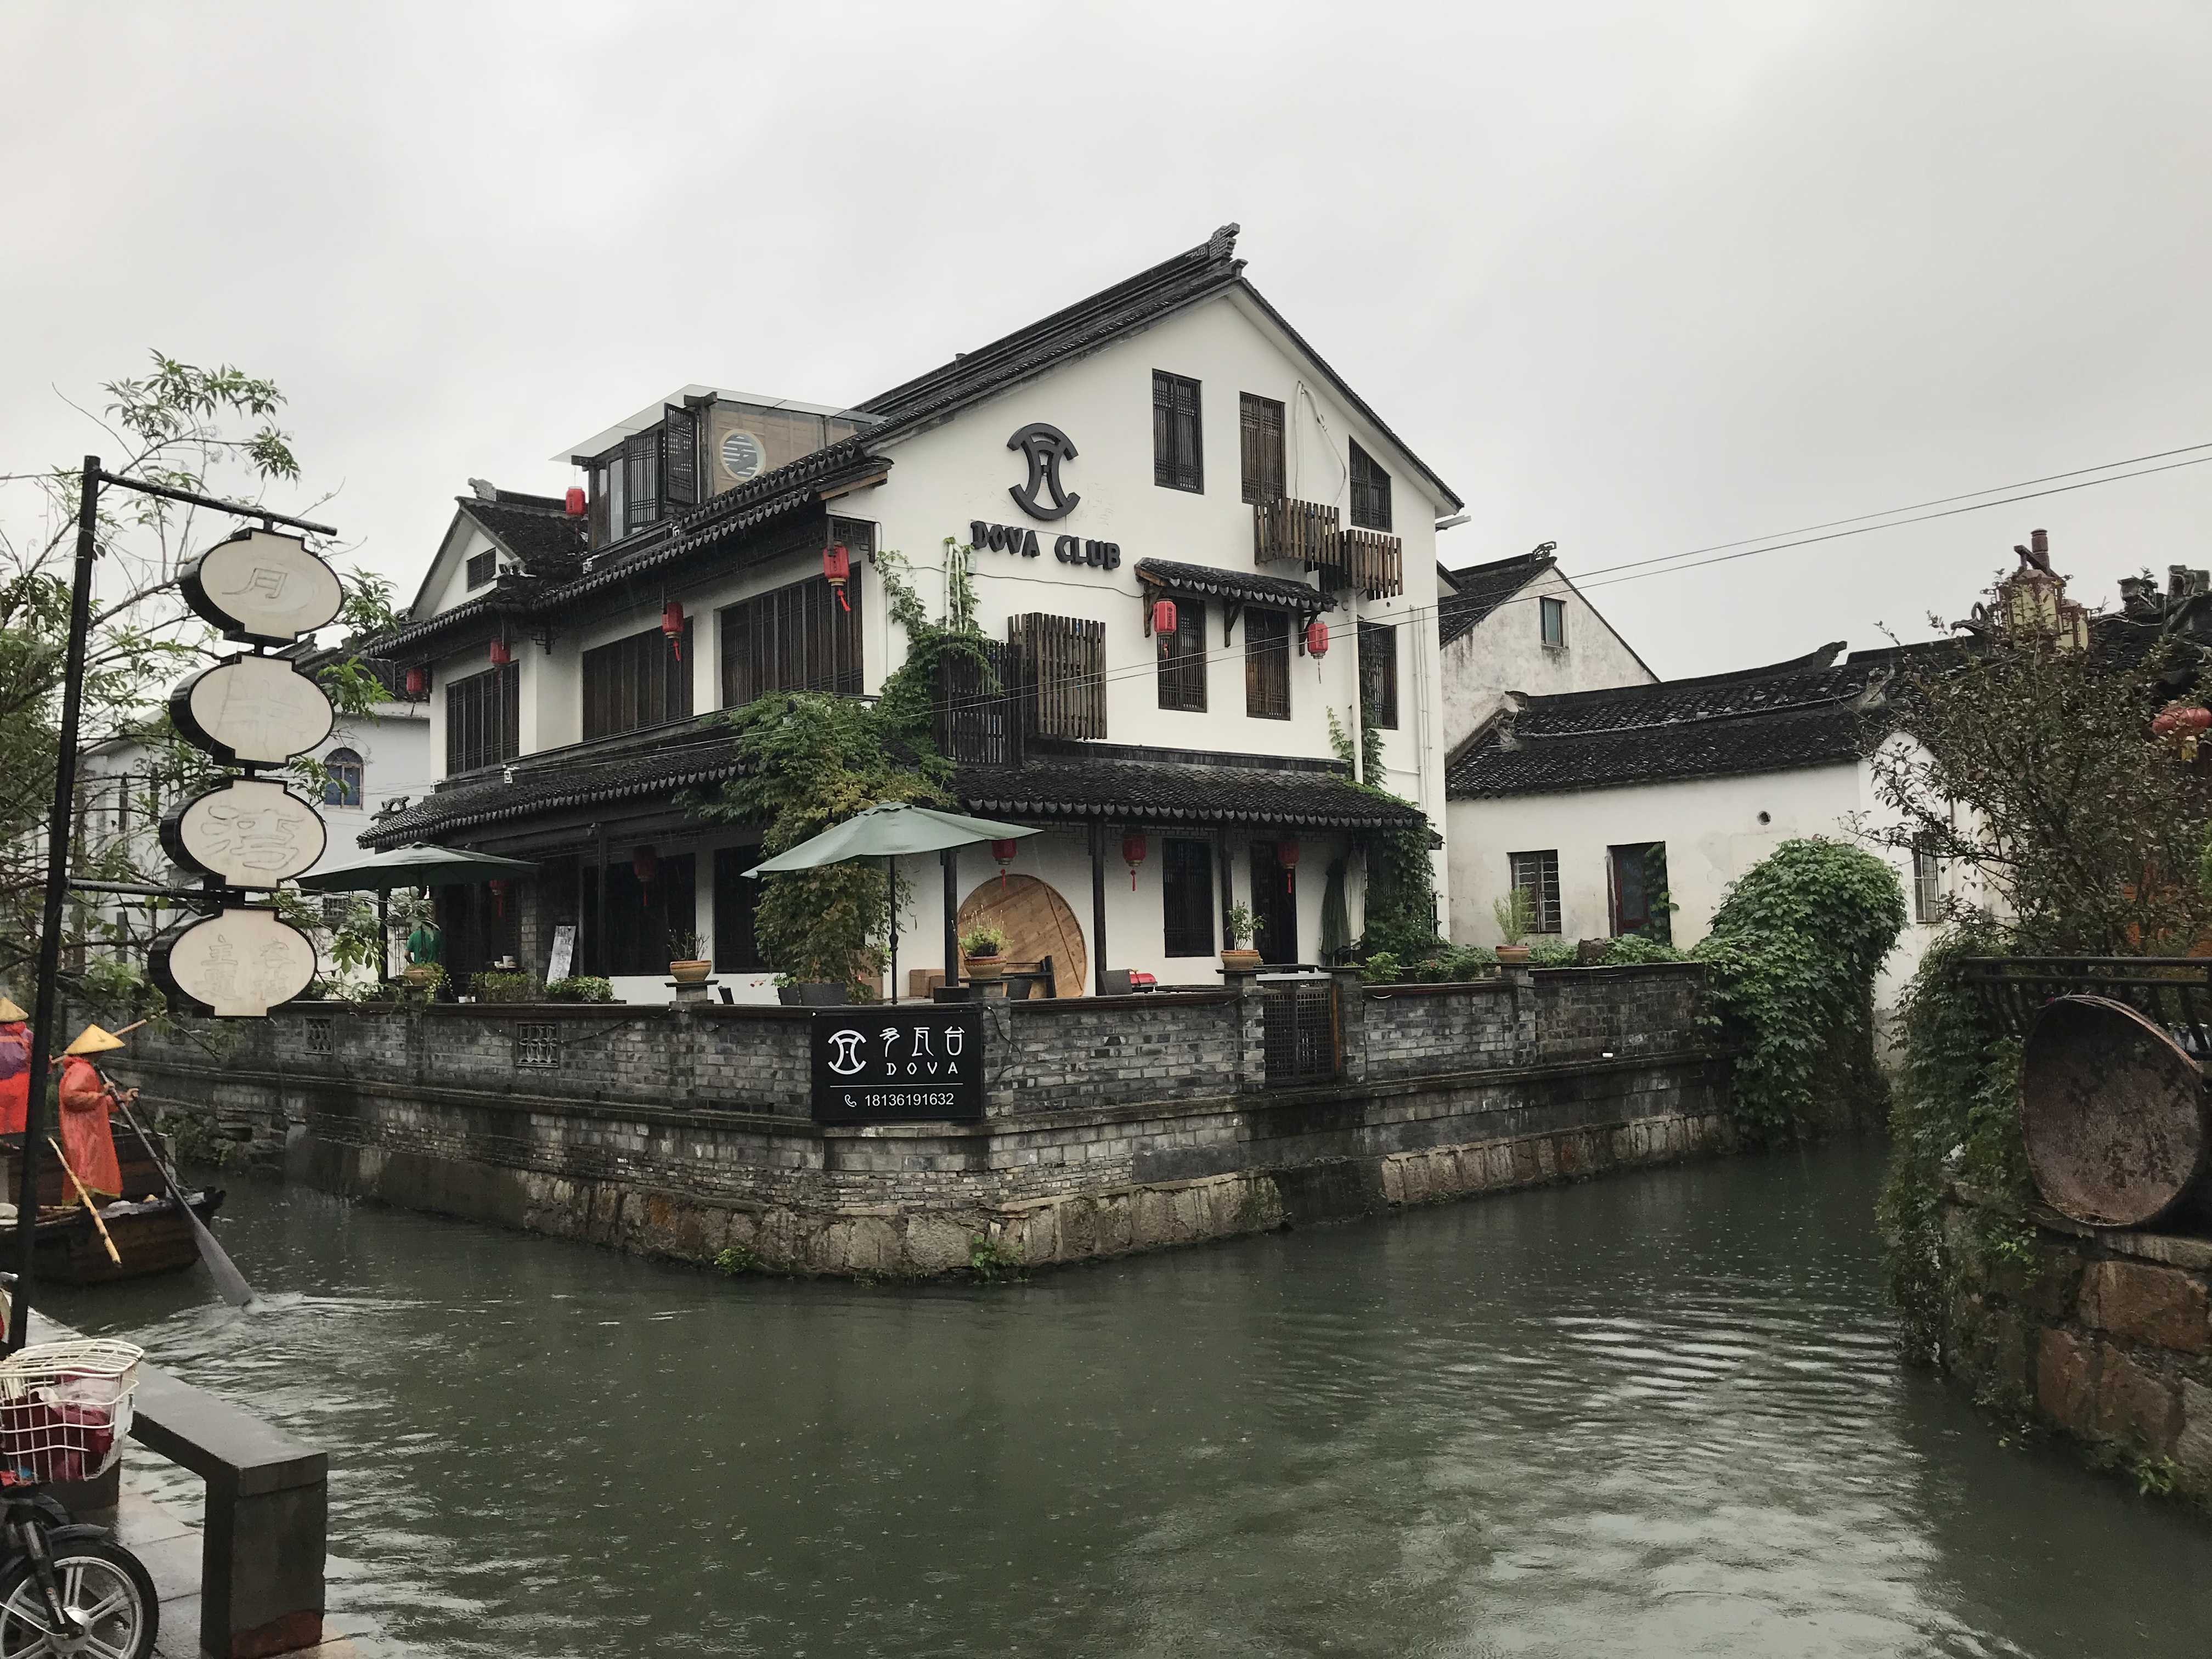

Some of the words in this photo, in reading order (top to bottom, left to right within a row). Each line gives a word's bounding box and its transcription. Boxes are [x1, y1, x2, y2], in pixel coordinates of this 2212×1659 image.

[970, 521, 1041, 558] DOVA
[1054, 535, 1121, 570] CLUB
[886, 1062, 958, 1076] DOVA
[865, 1093, 955, 1107] 18136191632
